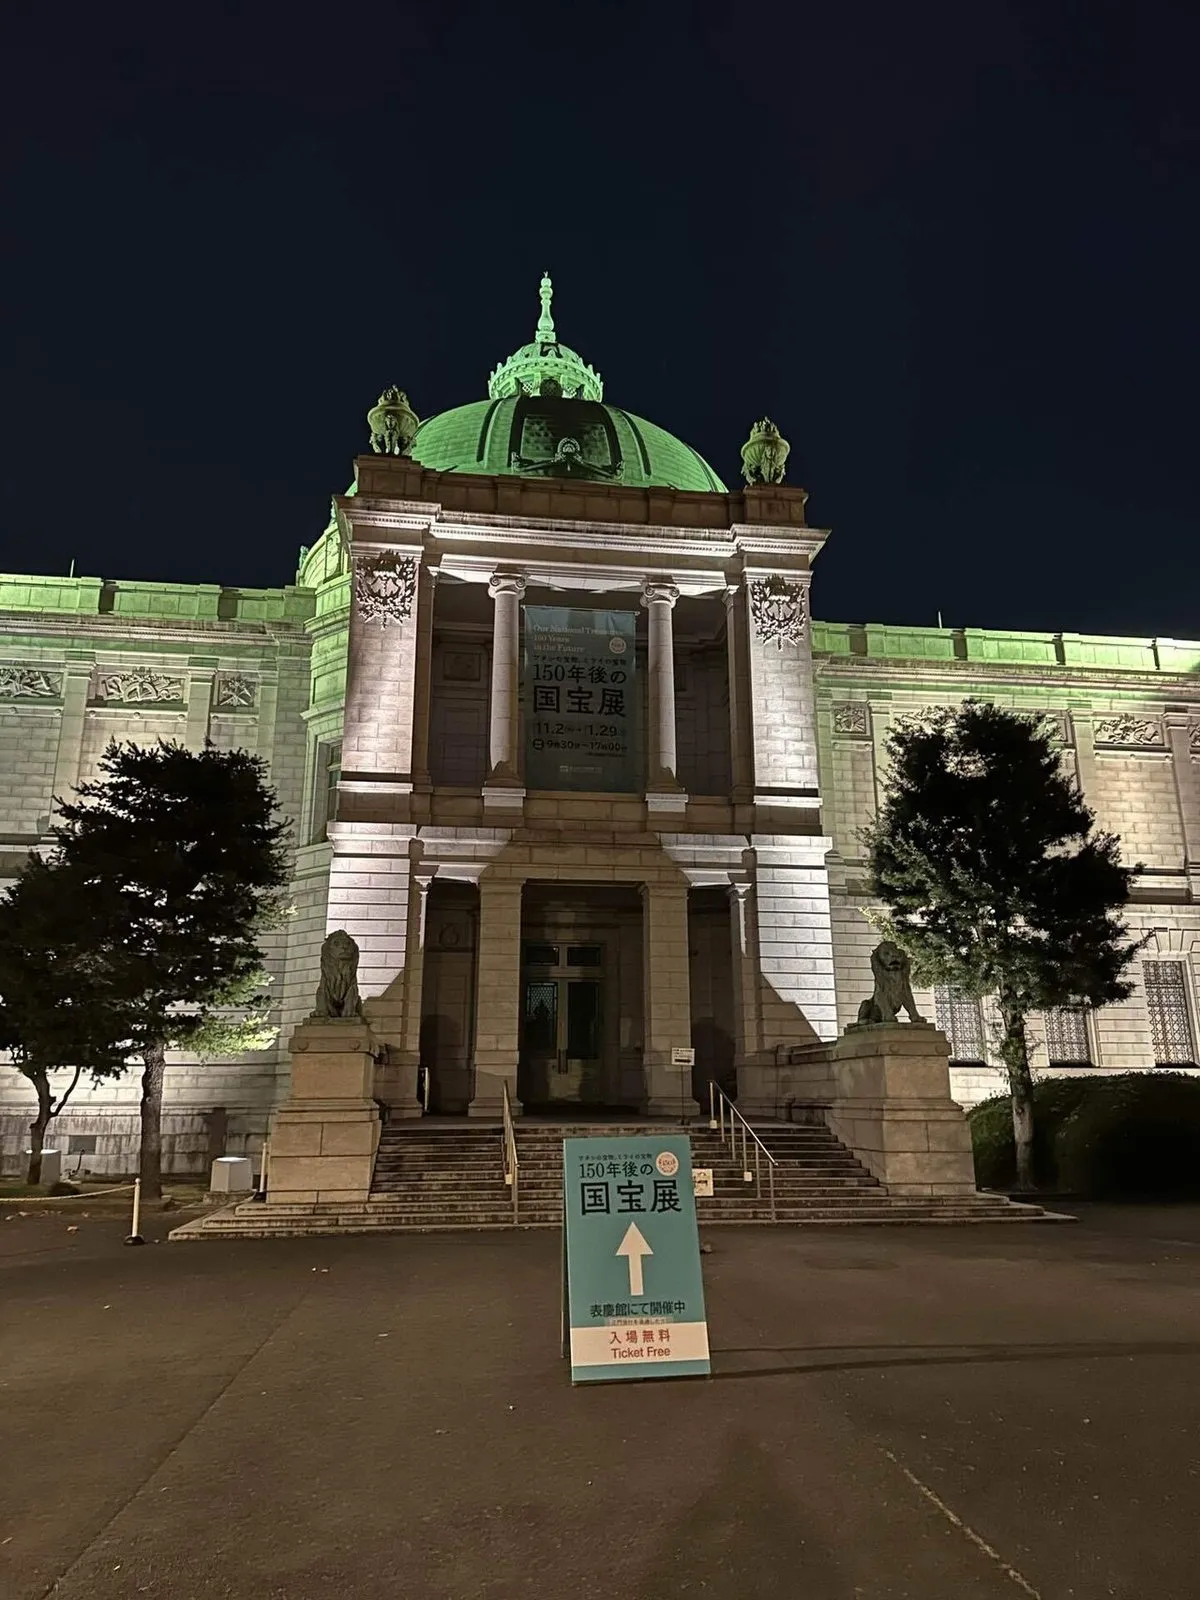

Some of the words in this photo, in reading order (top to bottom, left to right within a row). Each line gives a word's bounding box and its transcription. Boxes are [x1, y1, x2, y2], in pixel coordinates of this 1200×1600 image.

[533, 664, 626, 684] 150年後の
[534, 686, 626, 718] 国宝展
[579, 1161, 654, 1179] 150年後の
[581, 1179, 682, 1216] 国宝展
[590, 1300, 685, 1318] 表慶館にて開催中
[610, 1328, 671, 1344] 入場無料
[611, 1347, 644, 1359] Ticket
[647, 1346, 671, 1357] Free
